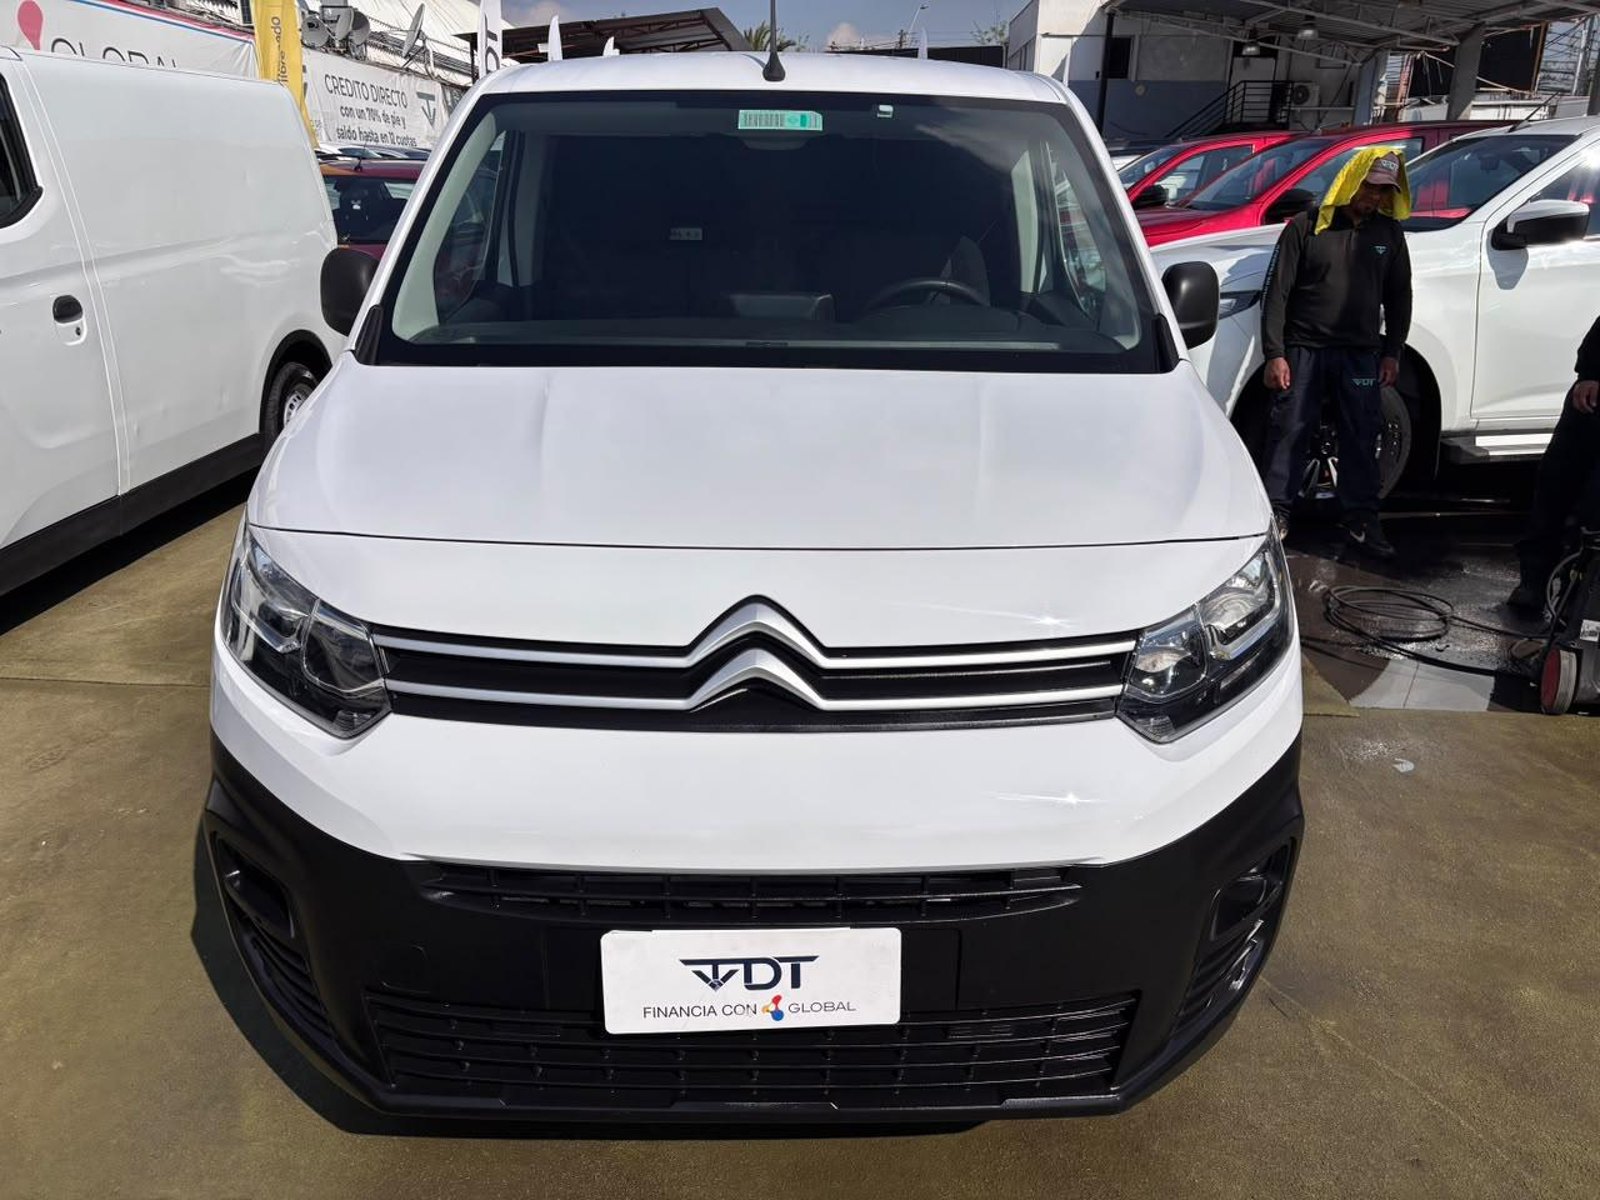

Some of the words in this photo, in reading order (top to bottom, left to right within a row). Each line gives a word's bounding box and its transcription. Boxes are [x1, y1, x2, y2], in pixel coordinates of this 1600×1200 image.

[324, 74, 370, 101] CREDITO
[370, 83, 408, 109] DIRECTO
[340, 105, 355, 118] con
[356, 109, 365, 120] un
[381, 109, 391, 124] de
[336, 125, 357, 141] saldo
[359, 126, 379, 143] hasta
[380, 133, 388, 143] en
[388, 131, 395, 145] 12
[396, 134, 417, 147] cuotas
[643, 1005, 718, 1018] FINANCIA
[721, 1003, 757, 1016] CON
[788, 1001, 857, 1014] GLOBAL
